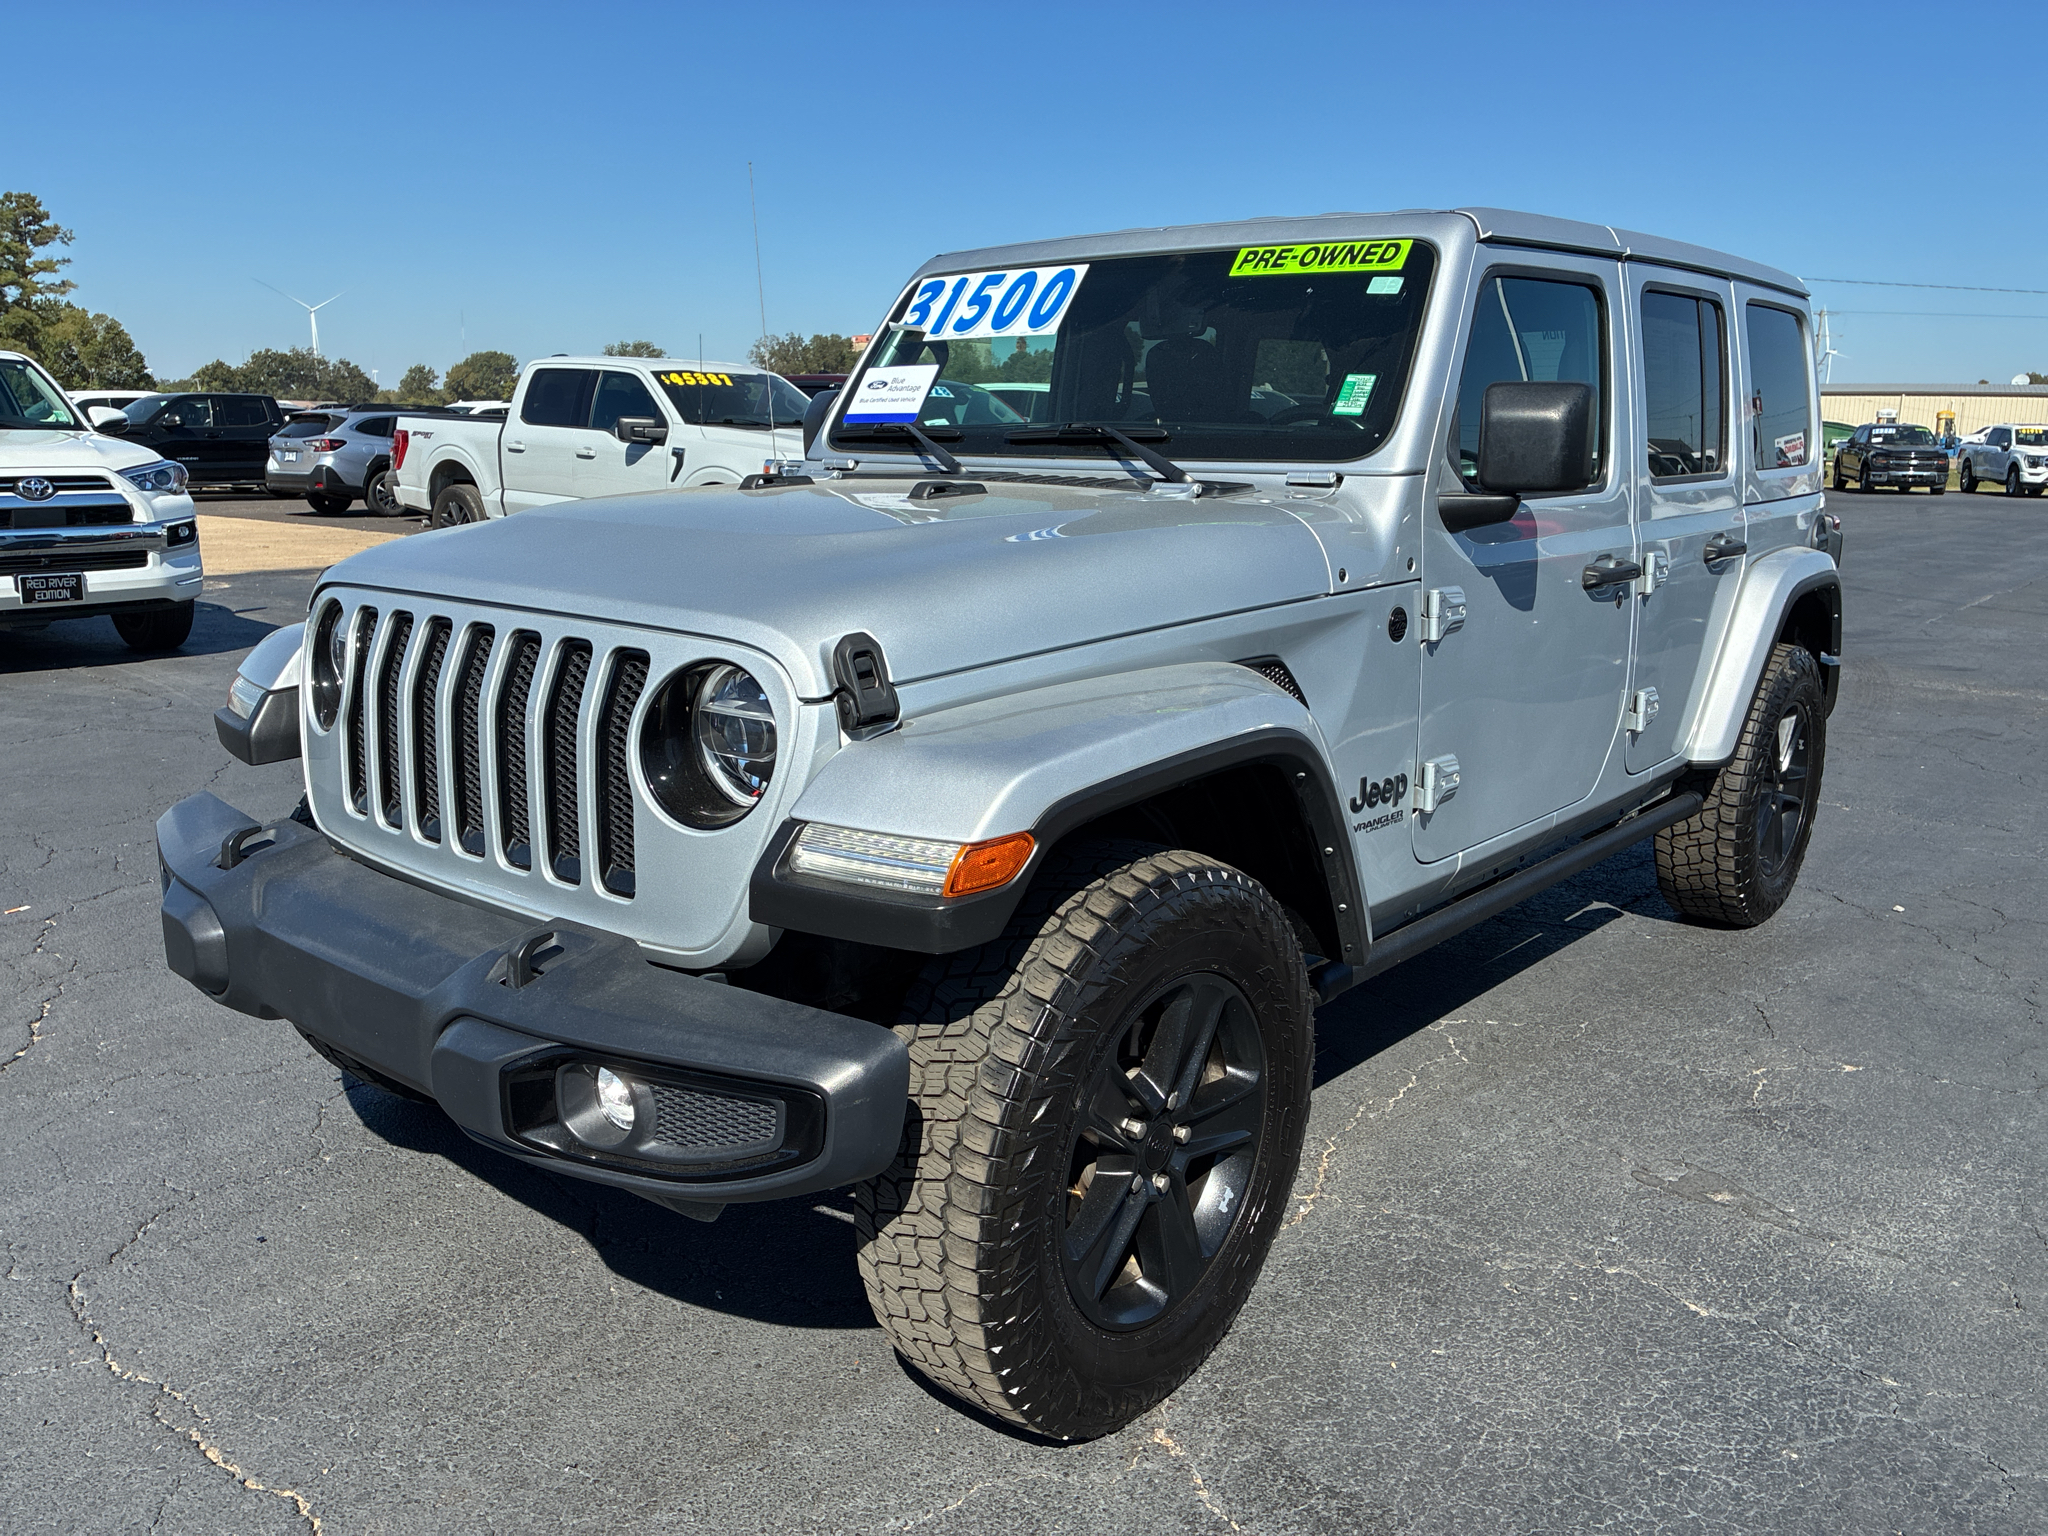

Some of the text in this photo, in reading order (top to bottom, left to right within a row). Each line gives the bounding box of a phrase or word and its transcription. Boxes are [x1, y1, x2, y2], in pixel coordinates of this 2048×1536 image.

[1236, 242, 1403, 270] PRE-OWNED
[904, 267, 1077, 336] 31500
[887, 385, 921, 393] Advantage
[890, 377, 906, 385] Blue
[26, 577, 77, 590] RED RIVER
[35, 589, 71, 600] EDITION
[1349, 772, 1408, 814] Jeep
[1353, 809, 1404, 833] WRANGLER
[1366, 817, 1404, 834] UNLIMITED
